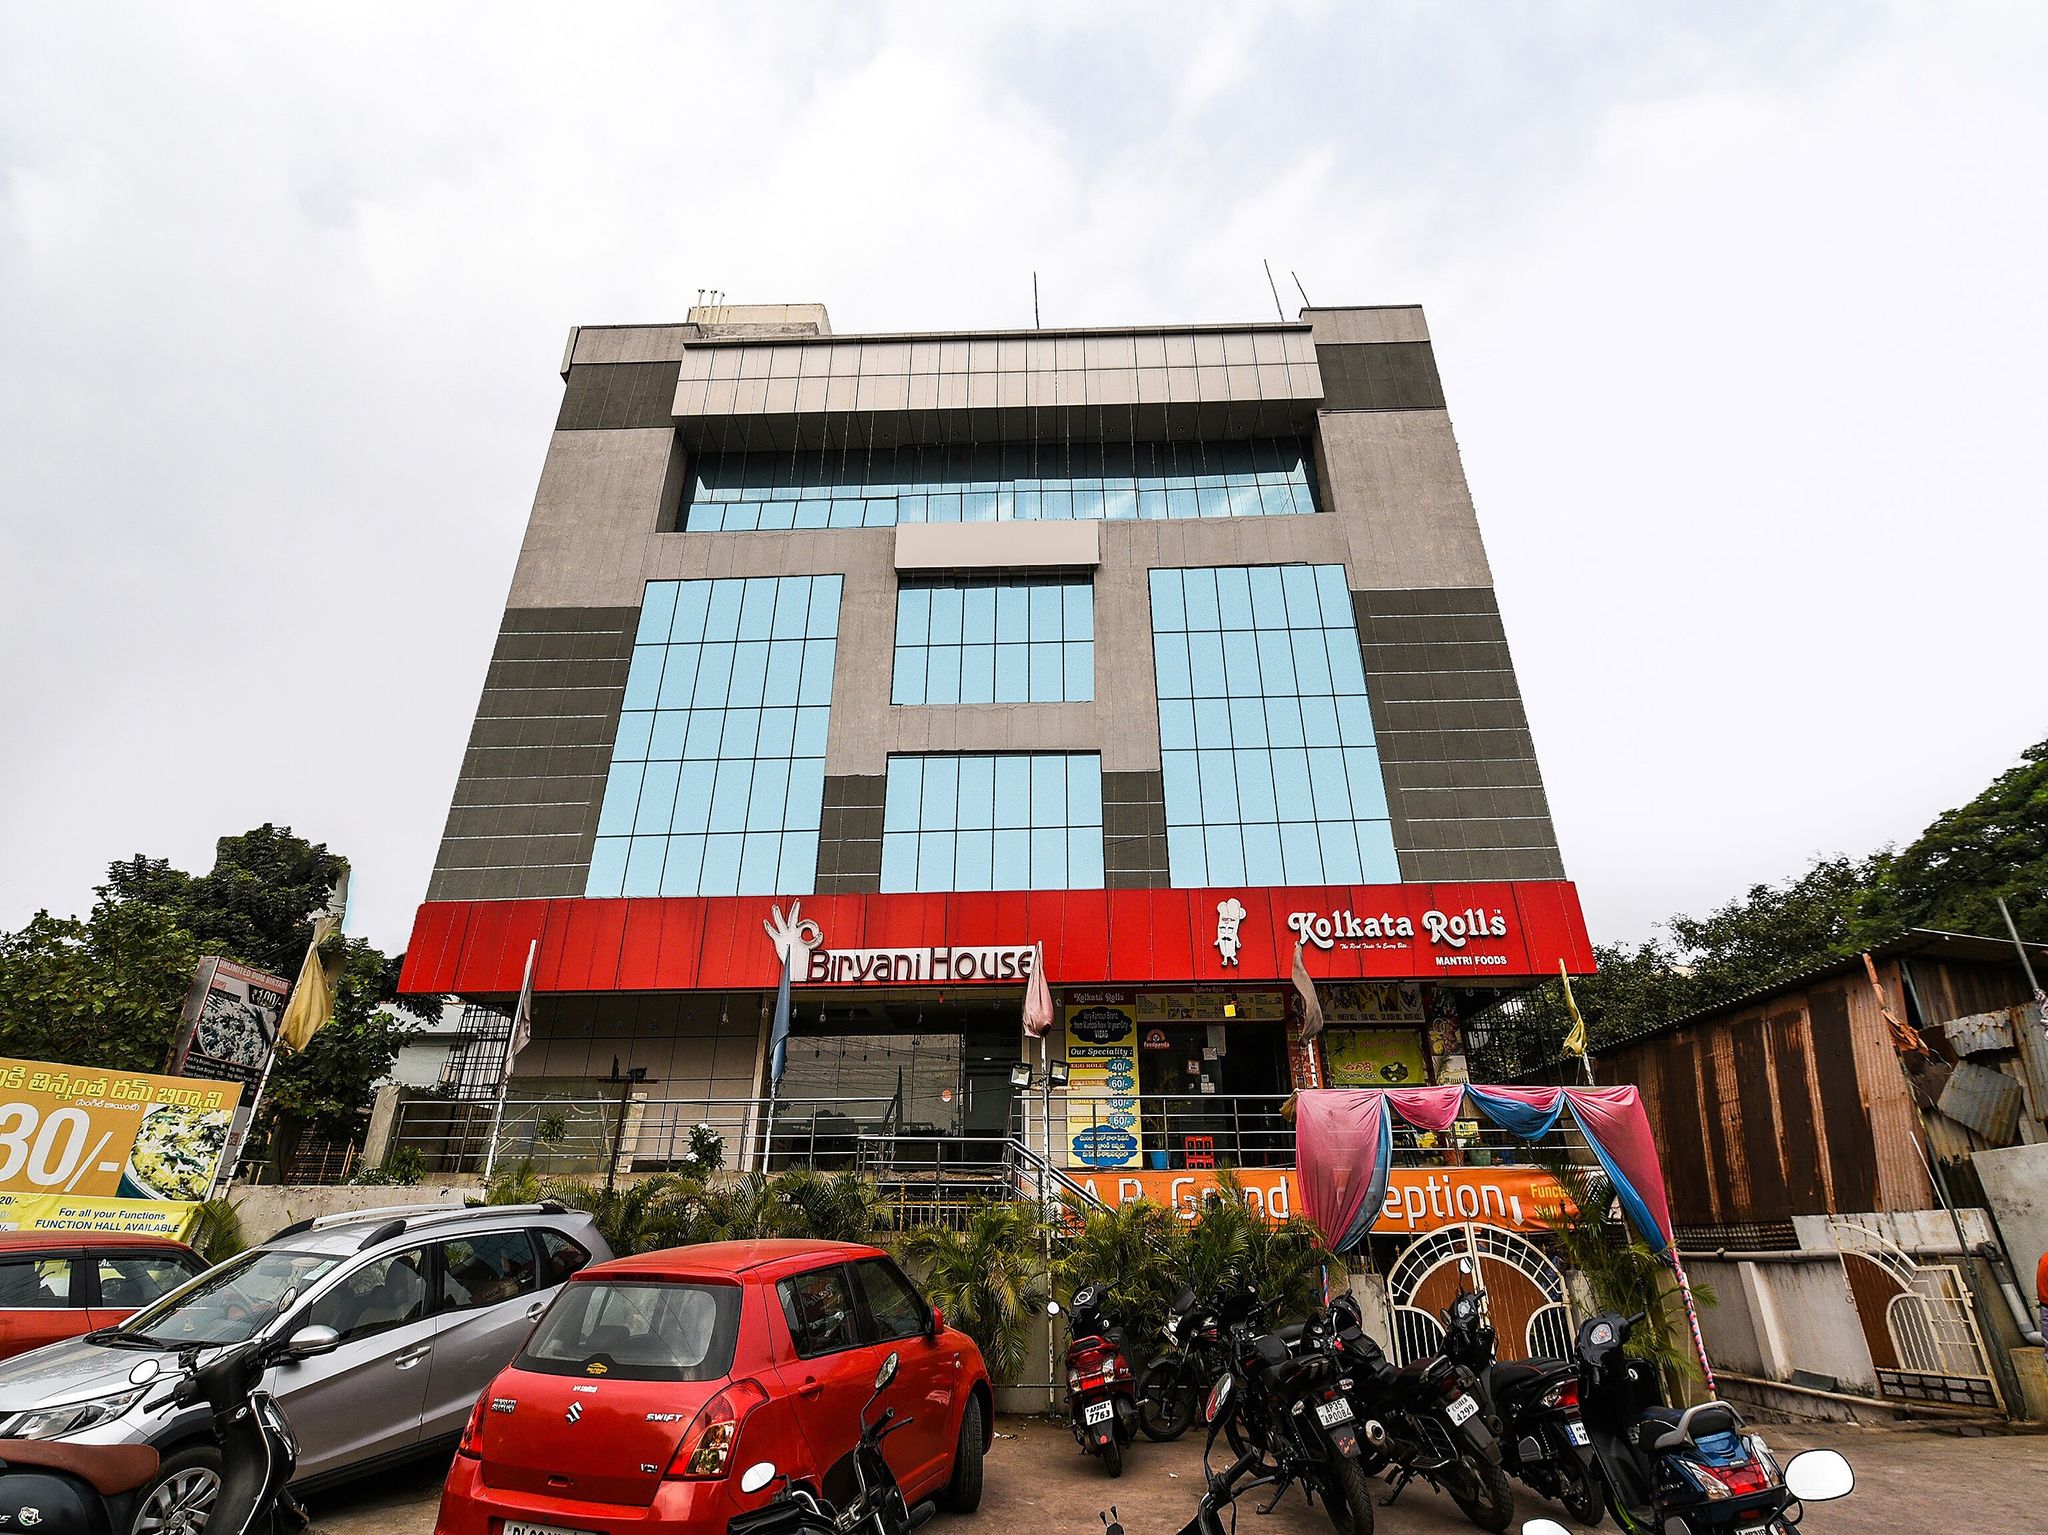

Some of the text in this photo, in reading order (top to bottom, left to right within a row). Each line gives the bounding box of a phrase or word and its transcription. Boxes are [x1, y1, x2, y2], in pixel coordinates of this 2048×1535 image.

[1287, 908, 1414, 949] Kolkata
[1421, 907, 1507, 948] Rolls
[807, 946, 1033, 982] Biryani House
[1435, 955, 1507, 966] MANTRI FOODS
[1073, 993, 1104, 1003] Kolkata
[1070, 1048, 1086, 1056] Our
[1111, 1062, 1130, 1071] 40/-
[1111, 1079, 1129, 1088] 60/-
[1171, 1175, 1289, 1220] Grnd
[58, 1207, 166, 1221] For all your Functions
[34, 1219, 180, 1233] FUNCTION HALL AVAILABLE
[646, 1413, 684, 1422] SWIFT
[1089, 1409, 1110, 1423] 7763
[1456, 1403, 1475, 1421] 4299
